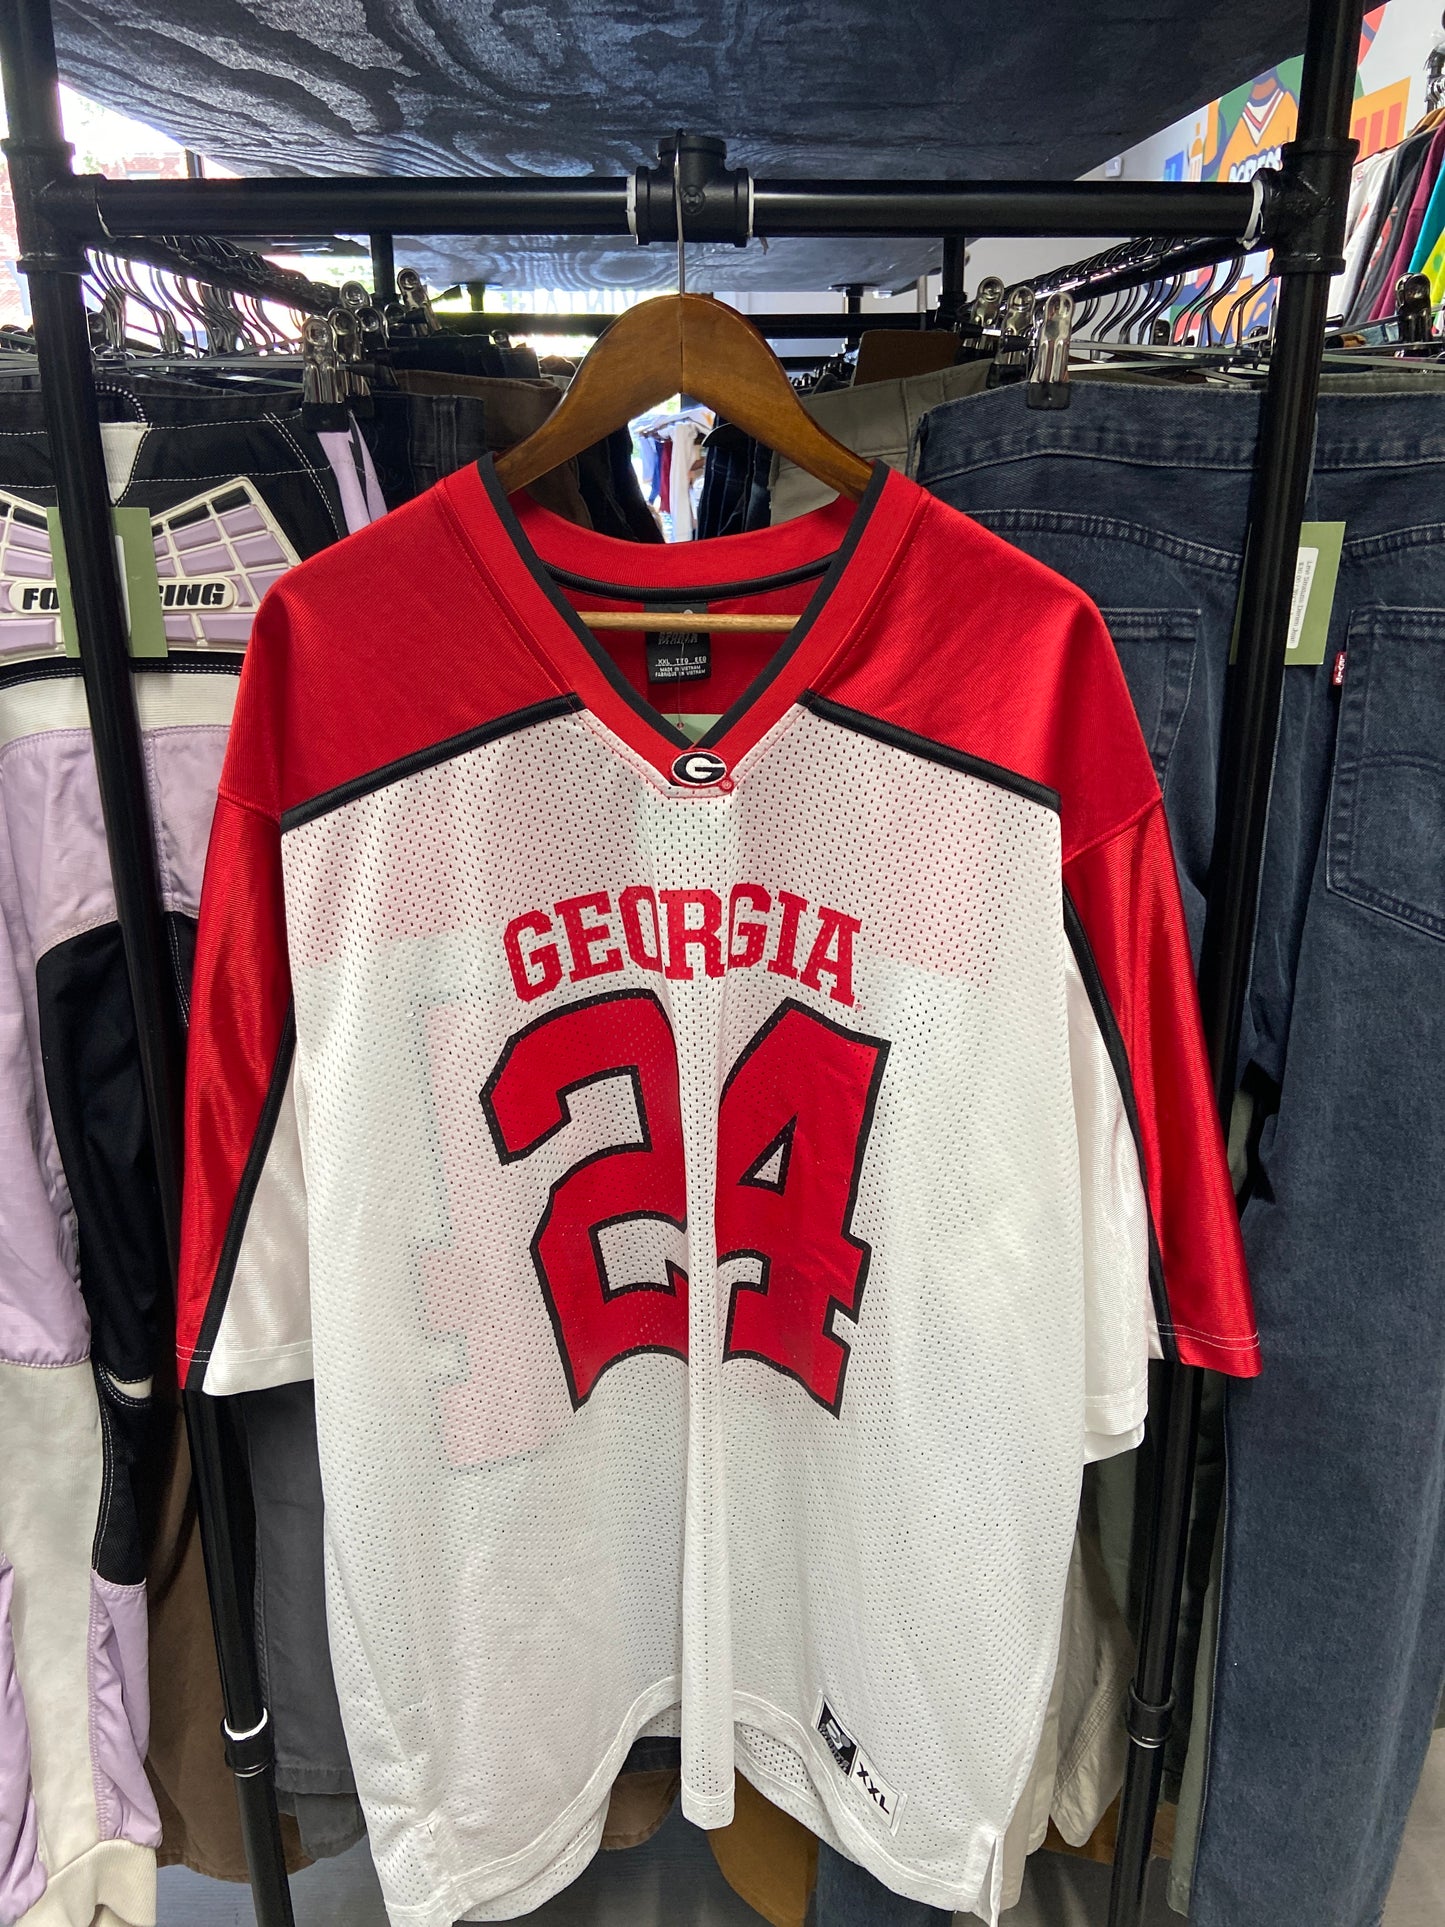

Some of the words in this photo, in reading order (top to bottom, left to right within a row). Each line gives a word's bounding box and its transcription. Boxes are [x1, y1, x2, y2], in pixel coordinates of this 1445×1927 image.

[22, 587, 59, 610] FO
[682, 755, 726, 781] G
[503, 882, 862, 1008] GEORGIA
[478, 987, 892, 1420] 24
[857, 1761, 890, 1815] XXL
